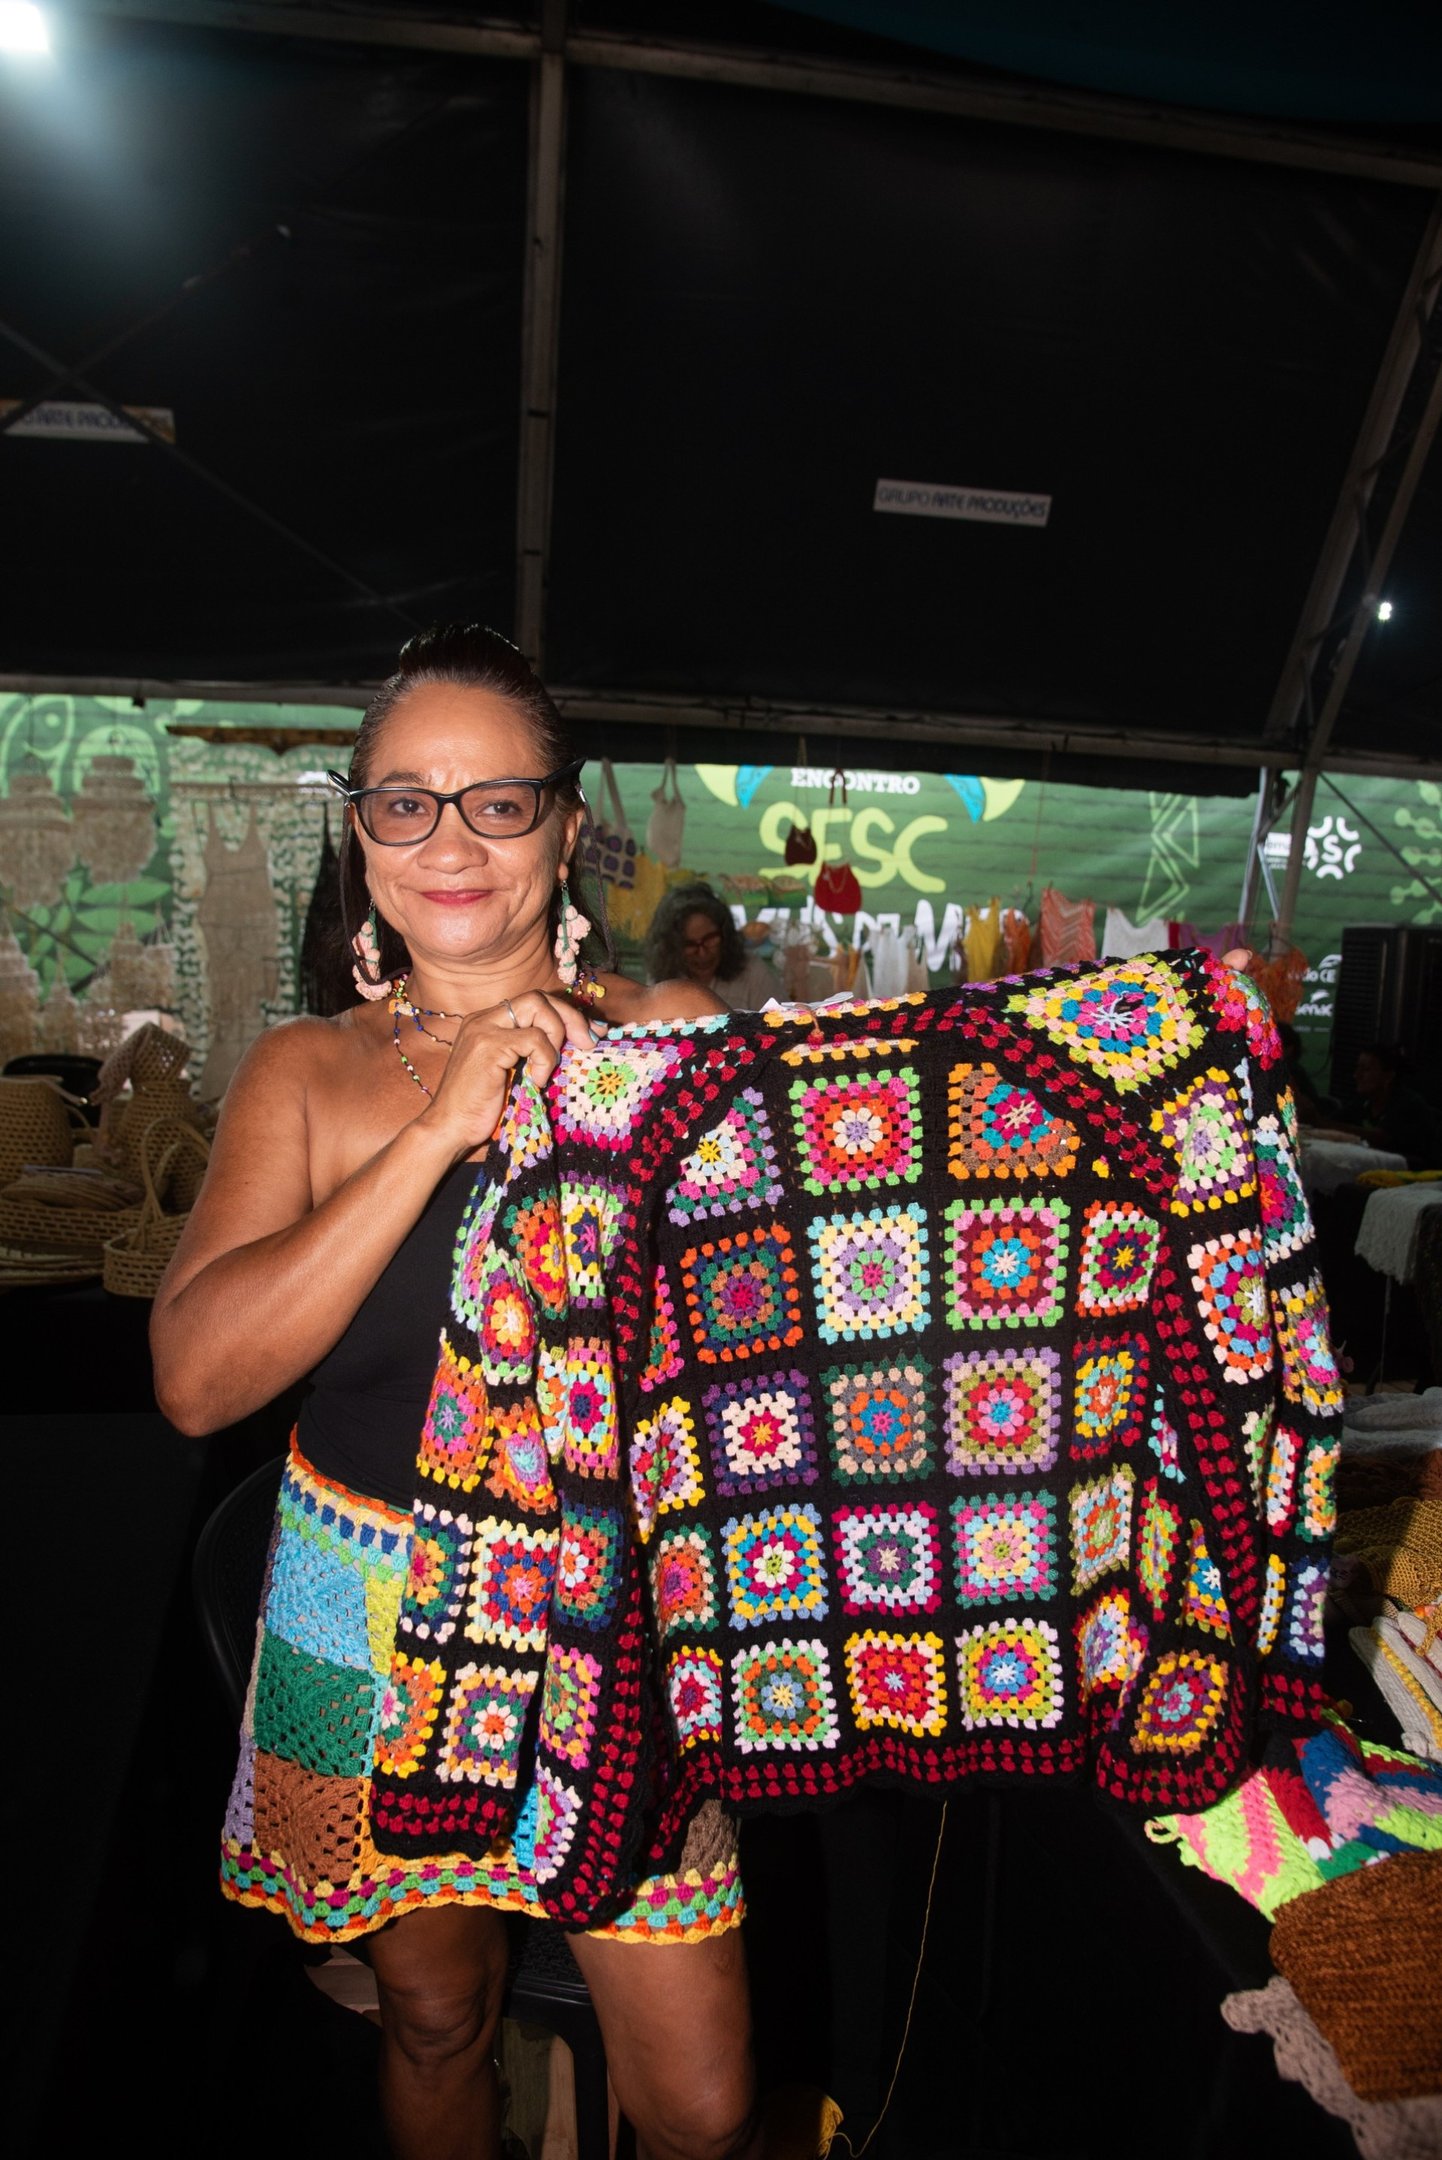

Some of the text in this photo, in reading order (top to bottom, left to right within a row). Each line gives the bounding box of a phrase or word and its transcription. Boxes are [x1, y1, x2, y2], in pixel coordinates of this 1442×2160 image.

[878, 486, 1047, 519] GRUPO ARTE PRODUÇÕES
[790, 767, 921, 795] ENCONTRO
